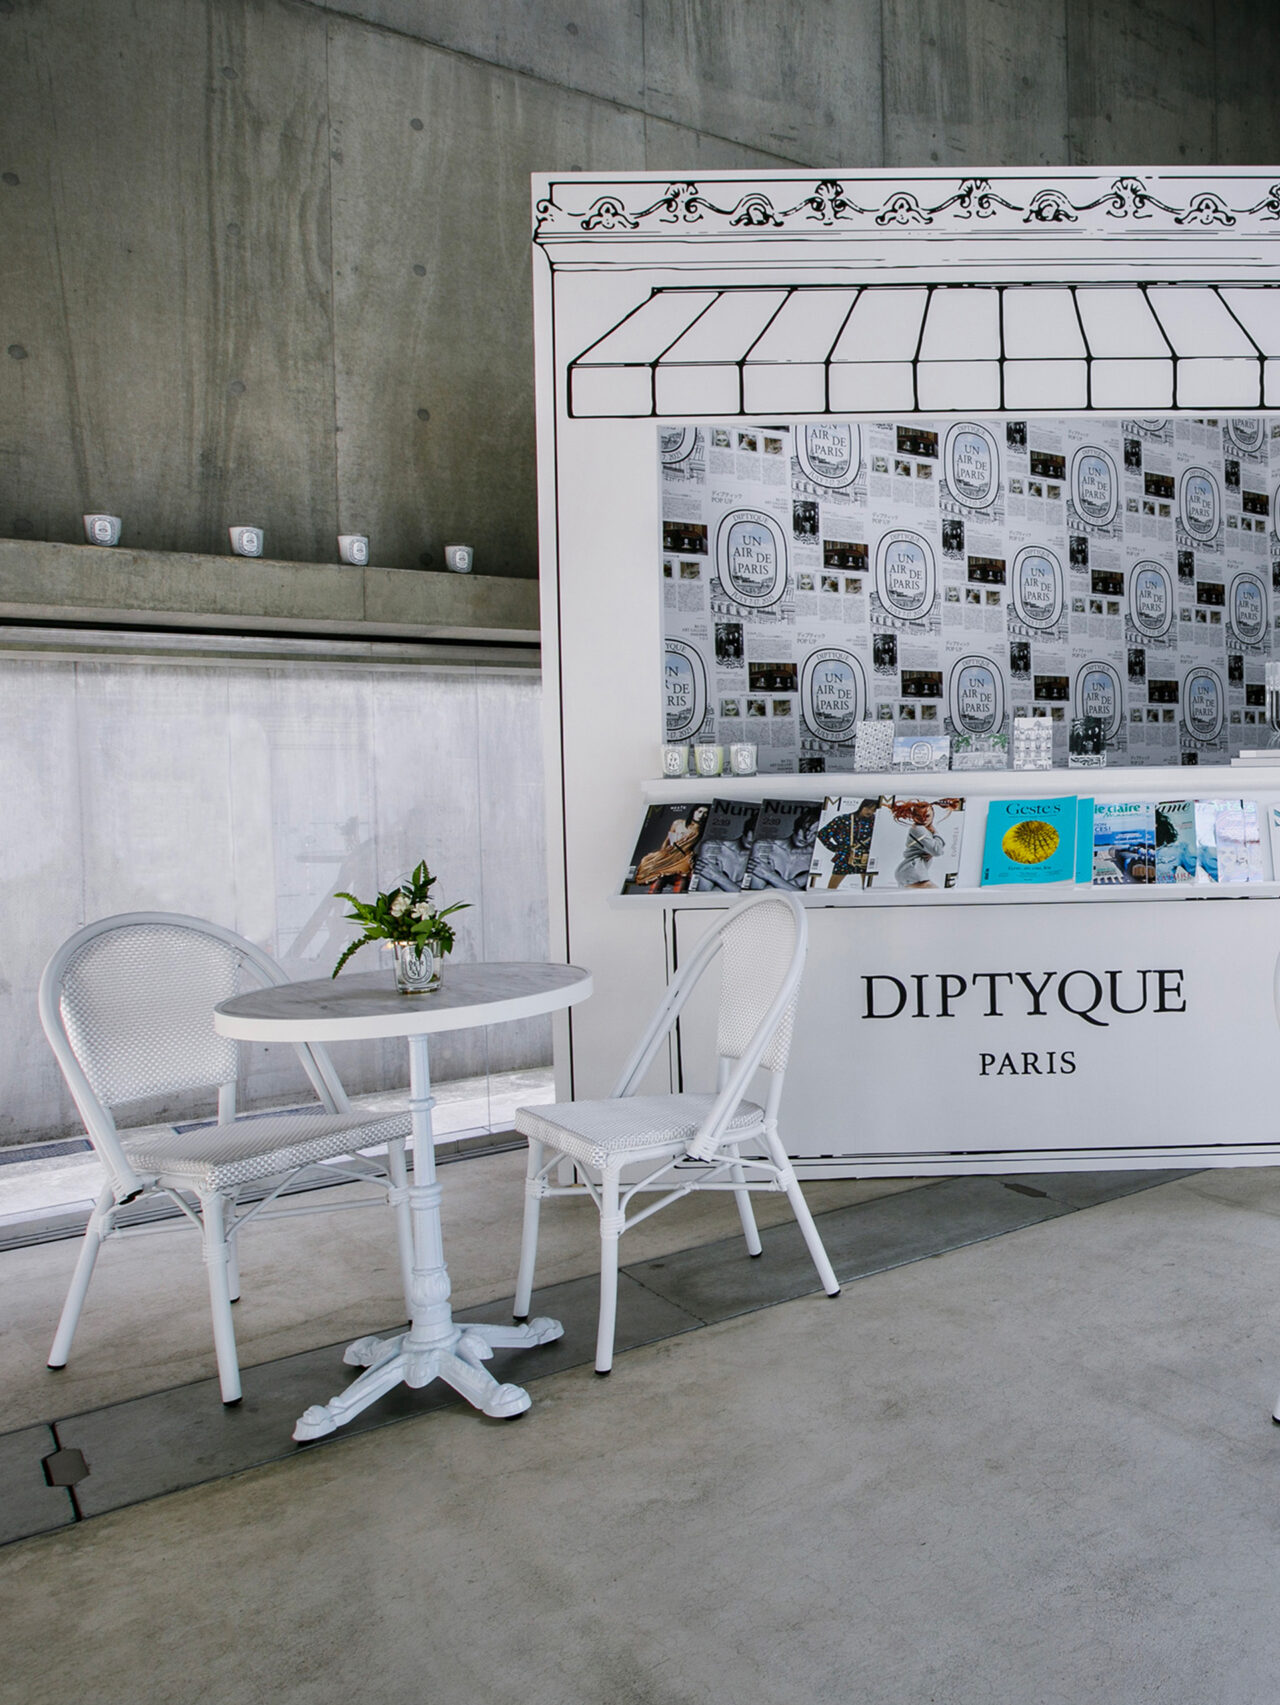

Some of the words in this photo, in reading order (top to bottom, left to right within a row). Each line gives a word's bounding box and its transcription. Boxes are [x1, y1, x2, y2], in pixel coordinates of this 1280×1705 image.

[811, 429, 829, 440] AIR
[832, 436, 847, 447] DE
[814, 445, 844, 457] PARIS
[964, 444, 980, 455] UN
[956, 454, 973, 465] AIR
[975, 461, 987, 471] DE
[960, 469, 986, 480] PARIS
[1088, 466, 1101, 477] UN
[1097, 481, 1108, 490] DE
[1084, 489, 1106, 500] PARIS
[732, 513, 770, 524] DIPTYQUE
[742, 535, 762, 546] UN
[733, 547, 753, 558] AIR
[756, 552, 772, 564] DE
[897, 553, 914, 564] UN
[738, 563, 769, 575] PARIS
[890, 564, 906, 574] AIR
[910, 570, 922, 580] DE
[1030, 568, 1045, 577] UN
[893, 578, 920, 590] PARIS
[1024, 578, 1039, 587] AIR
[1040, 582, 1052, 592] DE
[1028, 591, 1050, 601] PARIS
[664, 642, 688, 654] YQUE
[824, 673, 844, 684] UN
[968, 678, 984, 688] UN
[673, 683, 690, 694] DE
[817, 684, 835, 695] AIR
[838, 689, 852, 700] DE
[1092, 682, 1105, 691] UN
[667, 696, 687, 706] RIS
[962, 689, 978, 699] AIR
[980, 693, 992, 702] DE
[1086, 692, 1100, 701] AIR
[1101, 696, 1112, 705] DE
[820, 700, 850, 711] PARIS
[965, 702, 990, 712] PARIS
[1088, 705, 1110, 714] PARIS
[1006, 802, 1062, 815] Gestes
[1107, 803, 1141, 814] claire
[860, 968, 1187, 1026] DIPTYQUE
[979, 1051, 1077, 1076] PARIS
